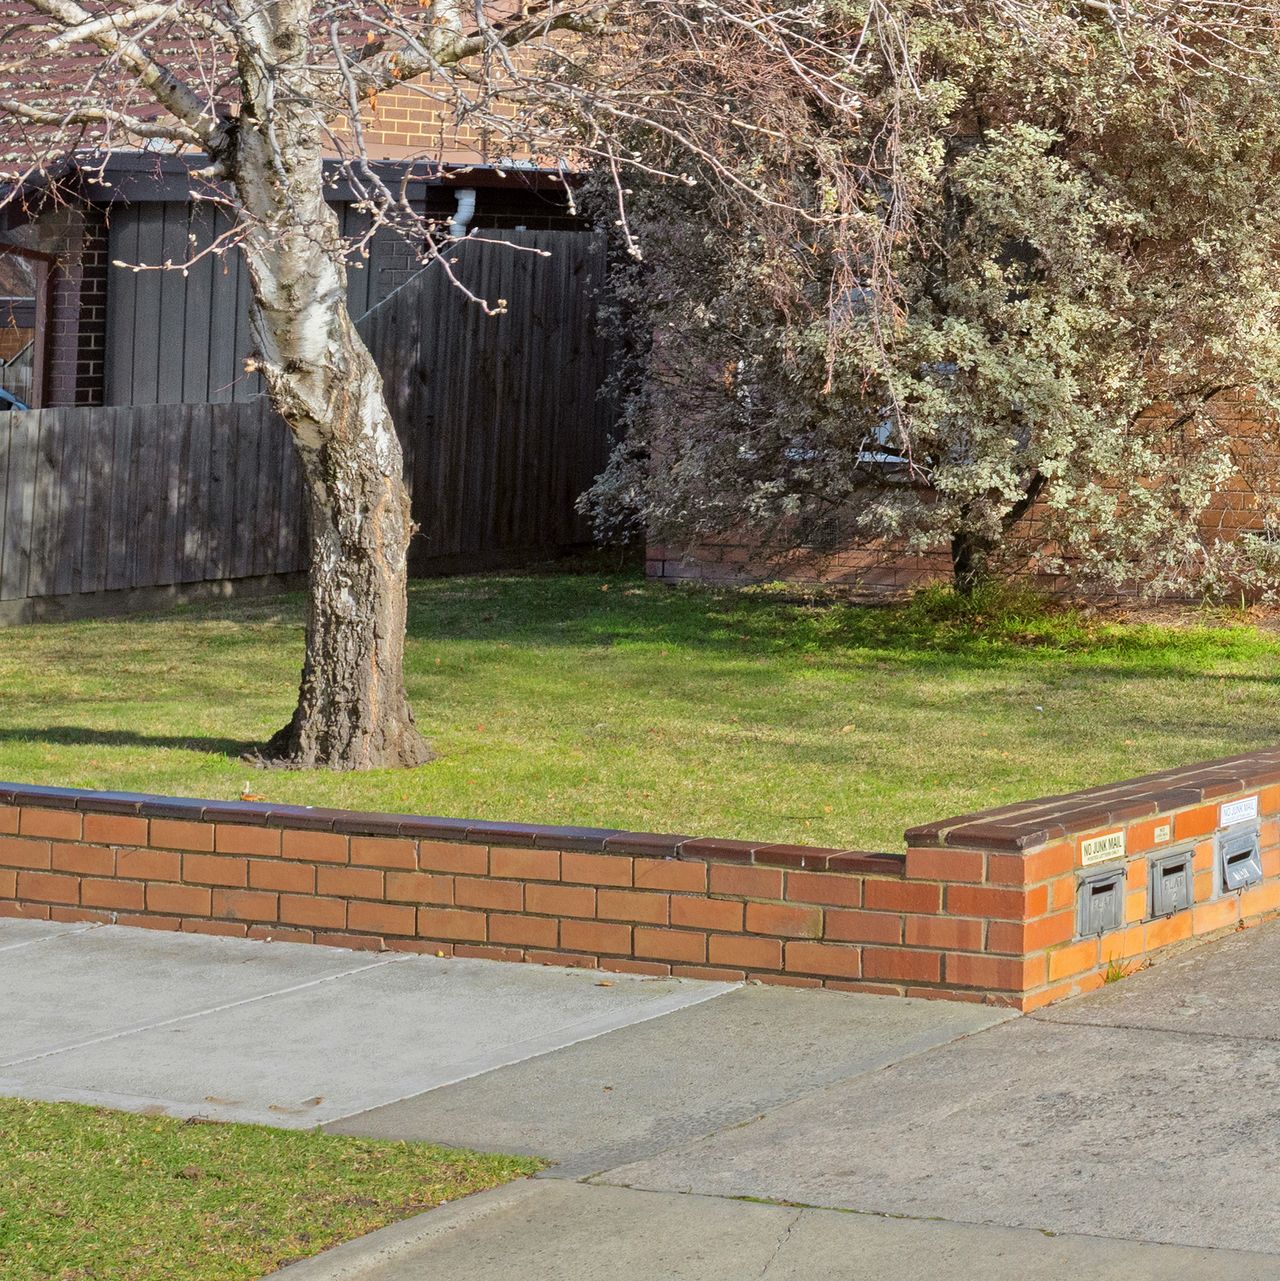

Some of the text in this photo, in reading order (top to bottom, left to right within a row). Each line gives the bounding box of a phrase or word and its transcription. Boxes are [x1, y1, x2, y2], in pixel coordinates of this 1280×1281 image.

[1223, 807, 1231, 817] NO
[1231, 803, 1243, 816] JUNK
[1243, 800, 1254, 812] MAIL
[1083, 835, 1122, 857] NO JUNK MAIL
[1164, 874, 1184, 891] FLAT
